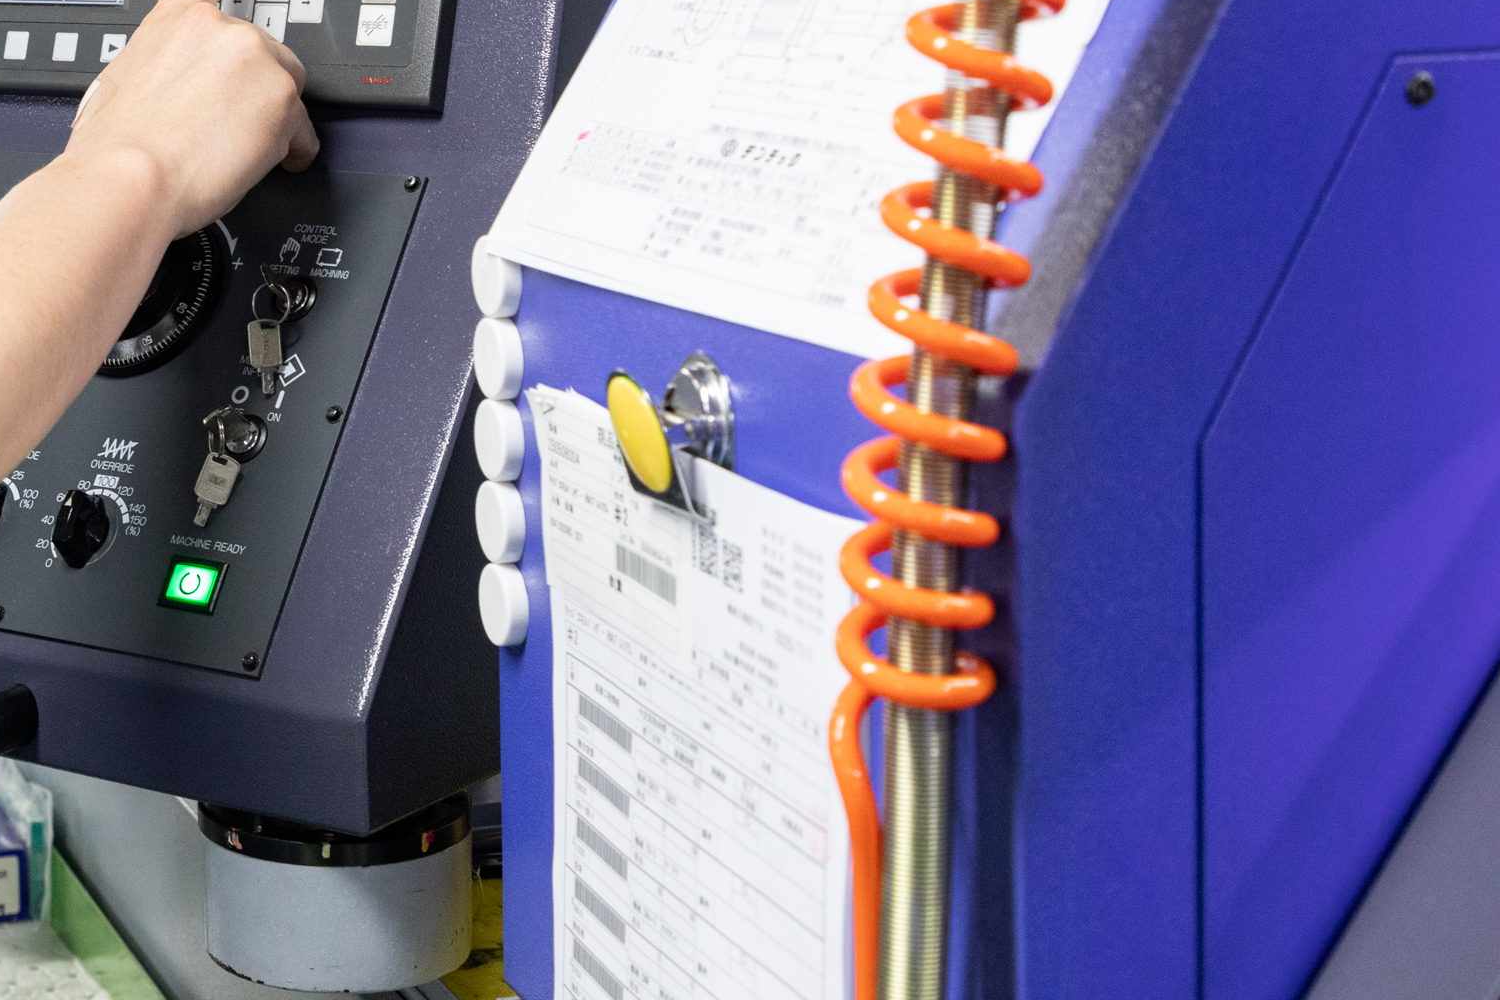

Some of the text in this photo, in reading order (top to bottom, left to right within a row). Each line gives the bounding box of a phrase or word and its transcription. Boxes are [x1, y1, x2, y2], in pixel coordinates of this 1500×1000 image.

[362, 21, 388, 30] RESET
[361, 77, 392, 85] FANUC
[294, 224, 338, 235] CONTROL
[301, 234, 328, 244] MODE
[193, 261, 202, 271] 70
[270, 264, 299, 275] SETTING
[310, 268, 349, 279] MACHINING
[267, 411, 282, 422] ON
[90, 459, 135, 474] OVERRIDE
[11, 470, 25, 481] 25
[77, 480, 91, 490] 80
[96, 476, 117, 487] 100
[22, 488, 39, 500] 100
[117, 486, 134, 497] 120
[19, 499, 34, 510] (%)
[128, 503, 146, 514] 140
[41, 514, 55, 525] 40
[129, 515, 147, 526] 150
[125, 525, 141, 537] (%)
[35, 538, 49, 549] 20
[170, 535, 247, 555] MACHINE READY
[45, 558, 53, 568] 0
